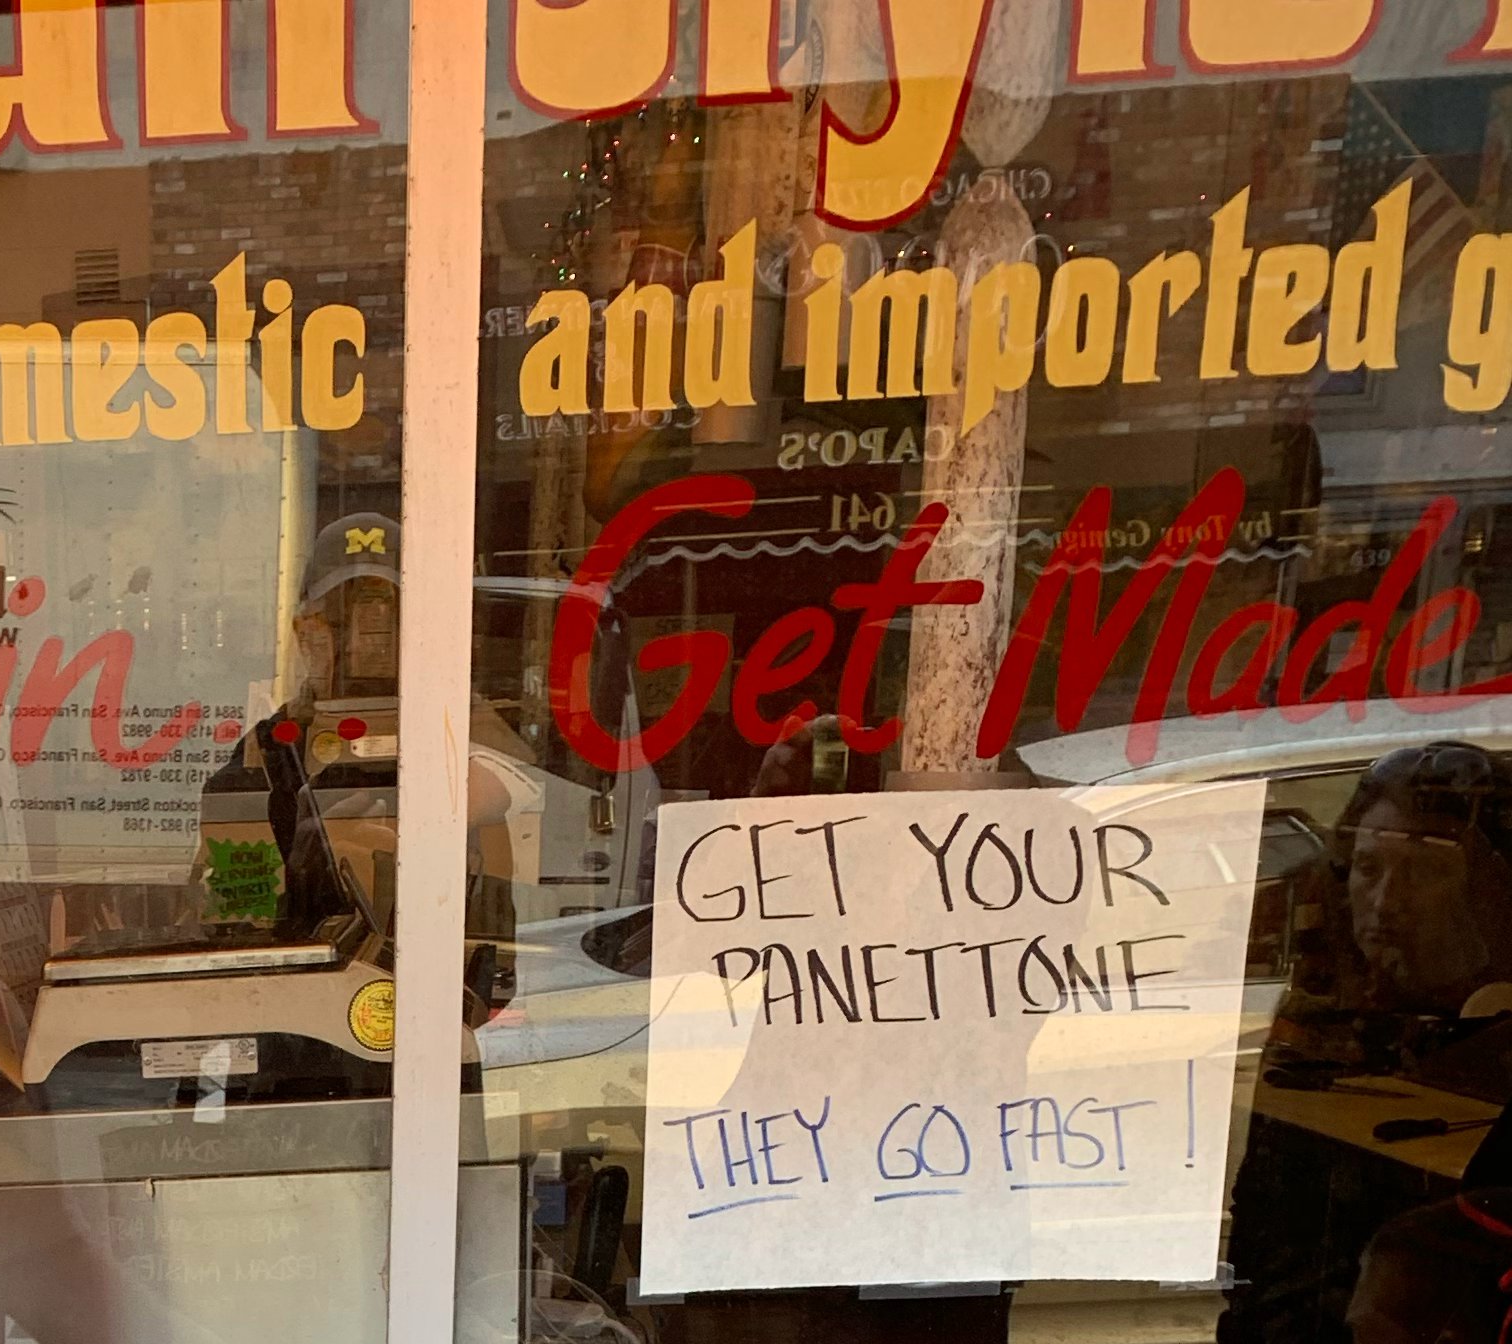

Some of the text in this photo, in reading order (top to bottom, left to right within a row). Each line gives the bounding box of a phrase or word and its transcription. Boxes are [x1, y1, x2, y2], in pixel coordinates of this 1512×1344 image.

[519, 217, 757, 416] and
[804, 178, 1413, 437] imported
[549, 464, 1512, 772] Get Made
[676, 810, 1171, 924] GET YOUR
[710, 932, 1191, 1028] PANETTONE
[662, 1094, 831, 1192] THEY
[875, 1102, 971, 1180] GO
